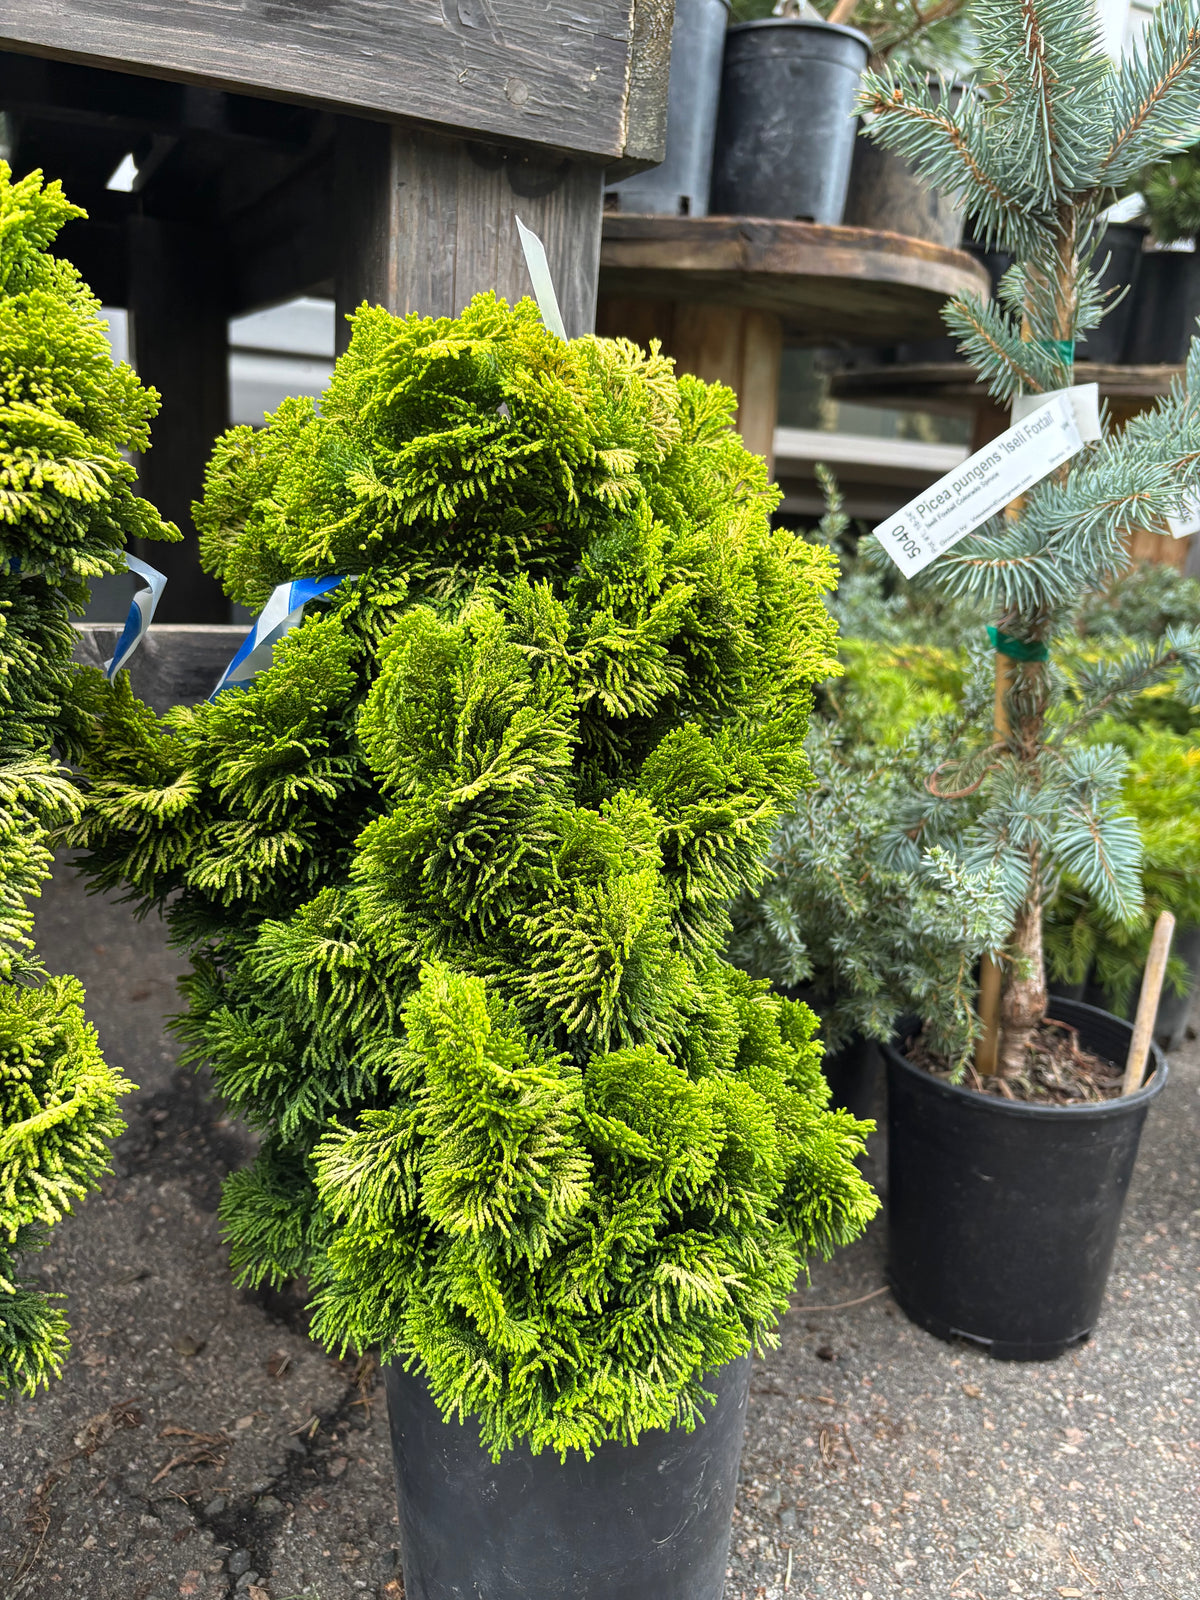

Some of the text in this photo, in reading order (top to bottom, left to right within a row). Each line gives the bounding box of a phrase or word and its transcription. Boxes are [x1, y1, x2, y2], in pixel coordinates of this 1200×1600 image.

[915, 488, 952, 519] Picea
[952, 452, 1003, 496] pungens
[891, 525, 922, 559] 5040
